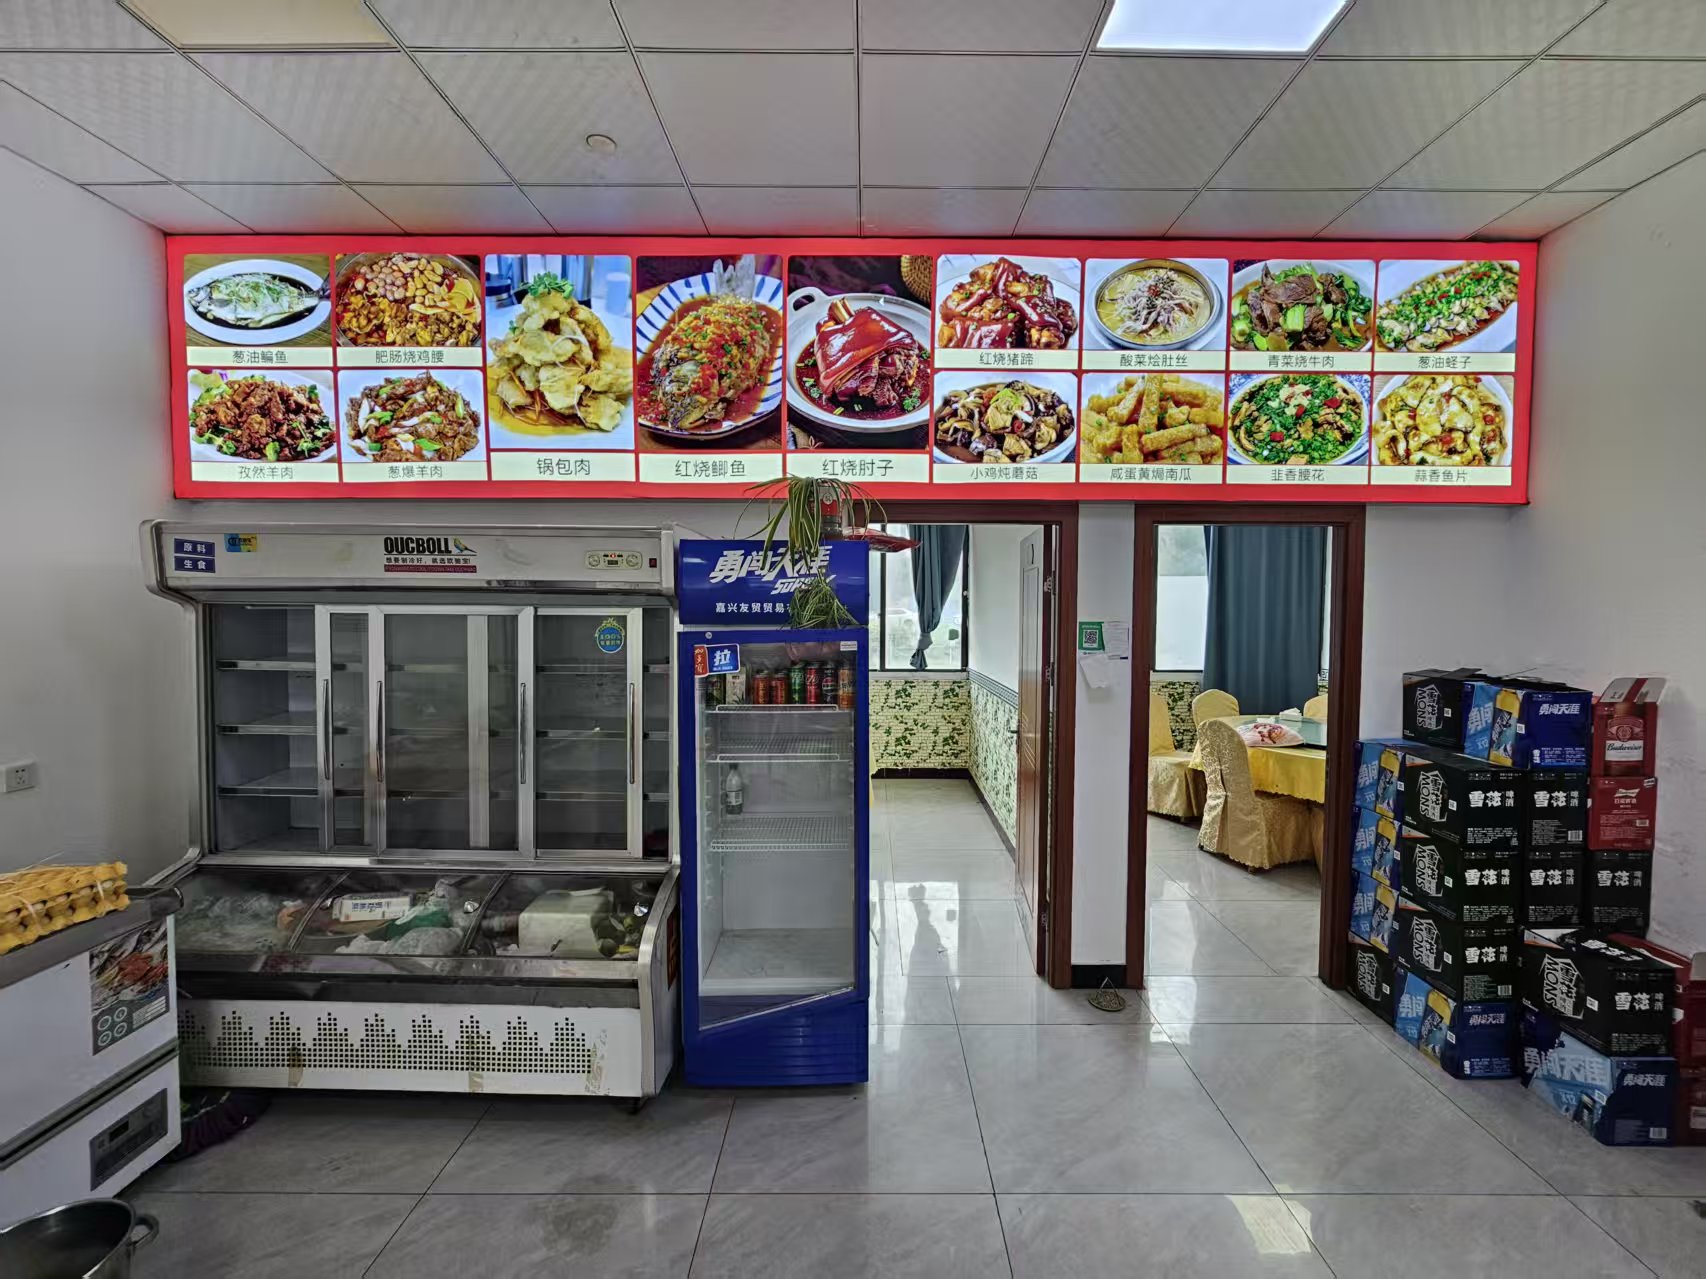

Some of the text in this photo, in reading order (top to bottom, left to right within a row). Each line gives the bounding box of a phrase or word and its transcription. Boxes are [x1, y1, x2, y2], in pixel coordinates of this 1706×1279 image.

[232, 350, 289, 365] 葱油鳊鱼
[375, 350, 444, 364] 肥肠烧鸡腰
[979, 352, 1034, 367] 红烧猪蹄
[1119, 354, 1188, 368] 酸菜烩肚丝
[1267, 355, 1335, 368] 青菜烧牛肉
[1418, 355, 1472, 369] 葱油蛏子
[238, 466, 293, 479] 孜然羊肉
[388, 466, 443, 479] 葱爆羊肉
[536, 458, 591, 476] 锅包肉
[674, 459, 746, 477] 红烧鲫鱼
[822, 459, 894, 477] 红烧肘子
[970, 467, 1038, 481] 小鸡炖蘑菇
[1110, 467, 1191, 482] 咸蛋黄焗南瓜
[1271, 468, 1324, 482] 韭香腰花
[1414, 469, 1468, 483] 蒜香鱼片
[183, 542, 206, 553] 原料
[384, 537, 452, 554] OUCBOLL
[183, 560, 207, 570] 生食
[713, 648, 731, 666] 拉
[1538, 703, 1581, 716] 勇闯天涯
[1607, 743, 1642, 752] Budweiser
[1468, 790, 1502, 807] 雪花
[1533, 790, 1567, 807] 雪花
[1464, 868, 1498, 886] 雪花
[1529, 869, 1563, 886] 雪花
[1597, 870, 1630, 887] 雪花
[1464, 946, 1496, 963] 雪花
[1615, 992, 1651, 1010] 雪花
[1623, 1074, 1666, 1087] 勇闯天涯
